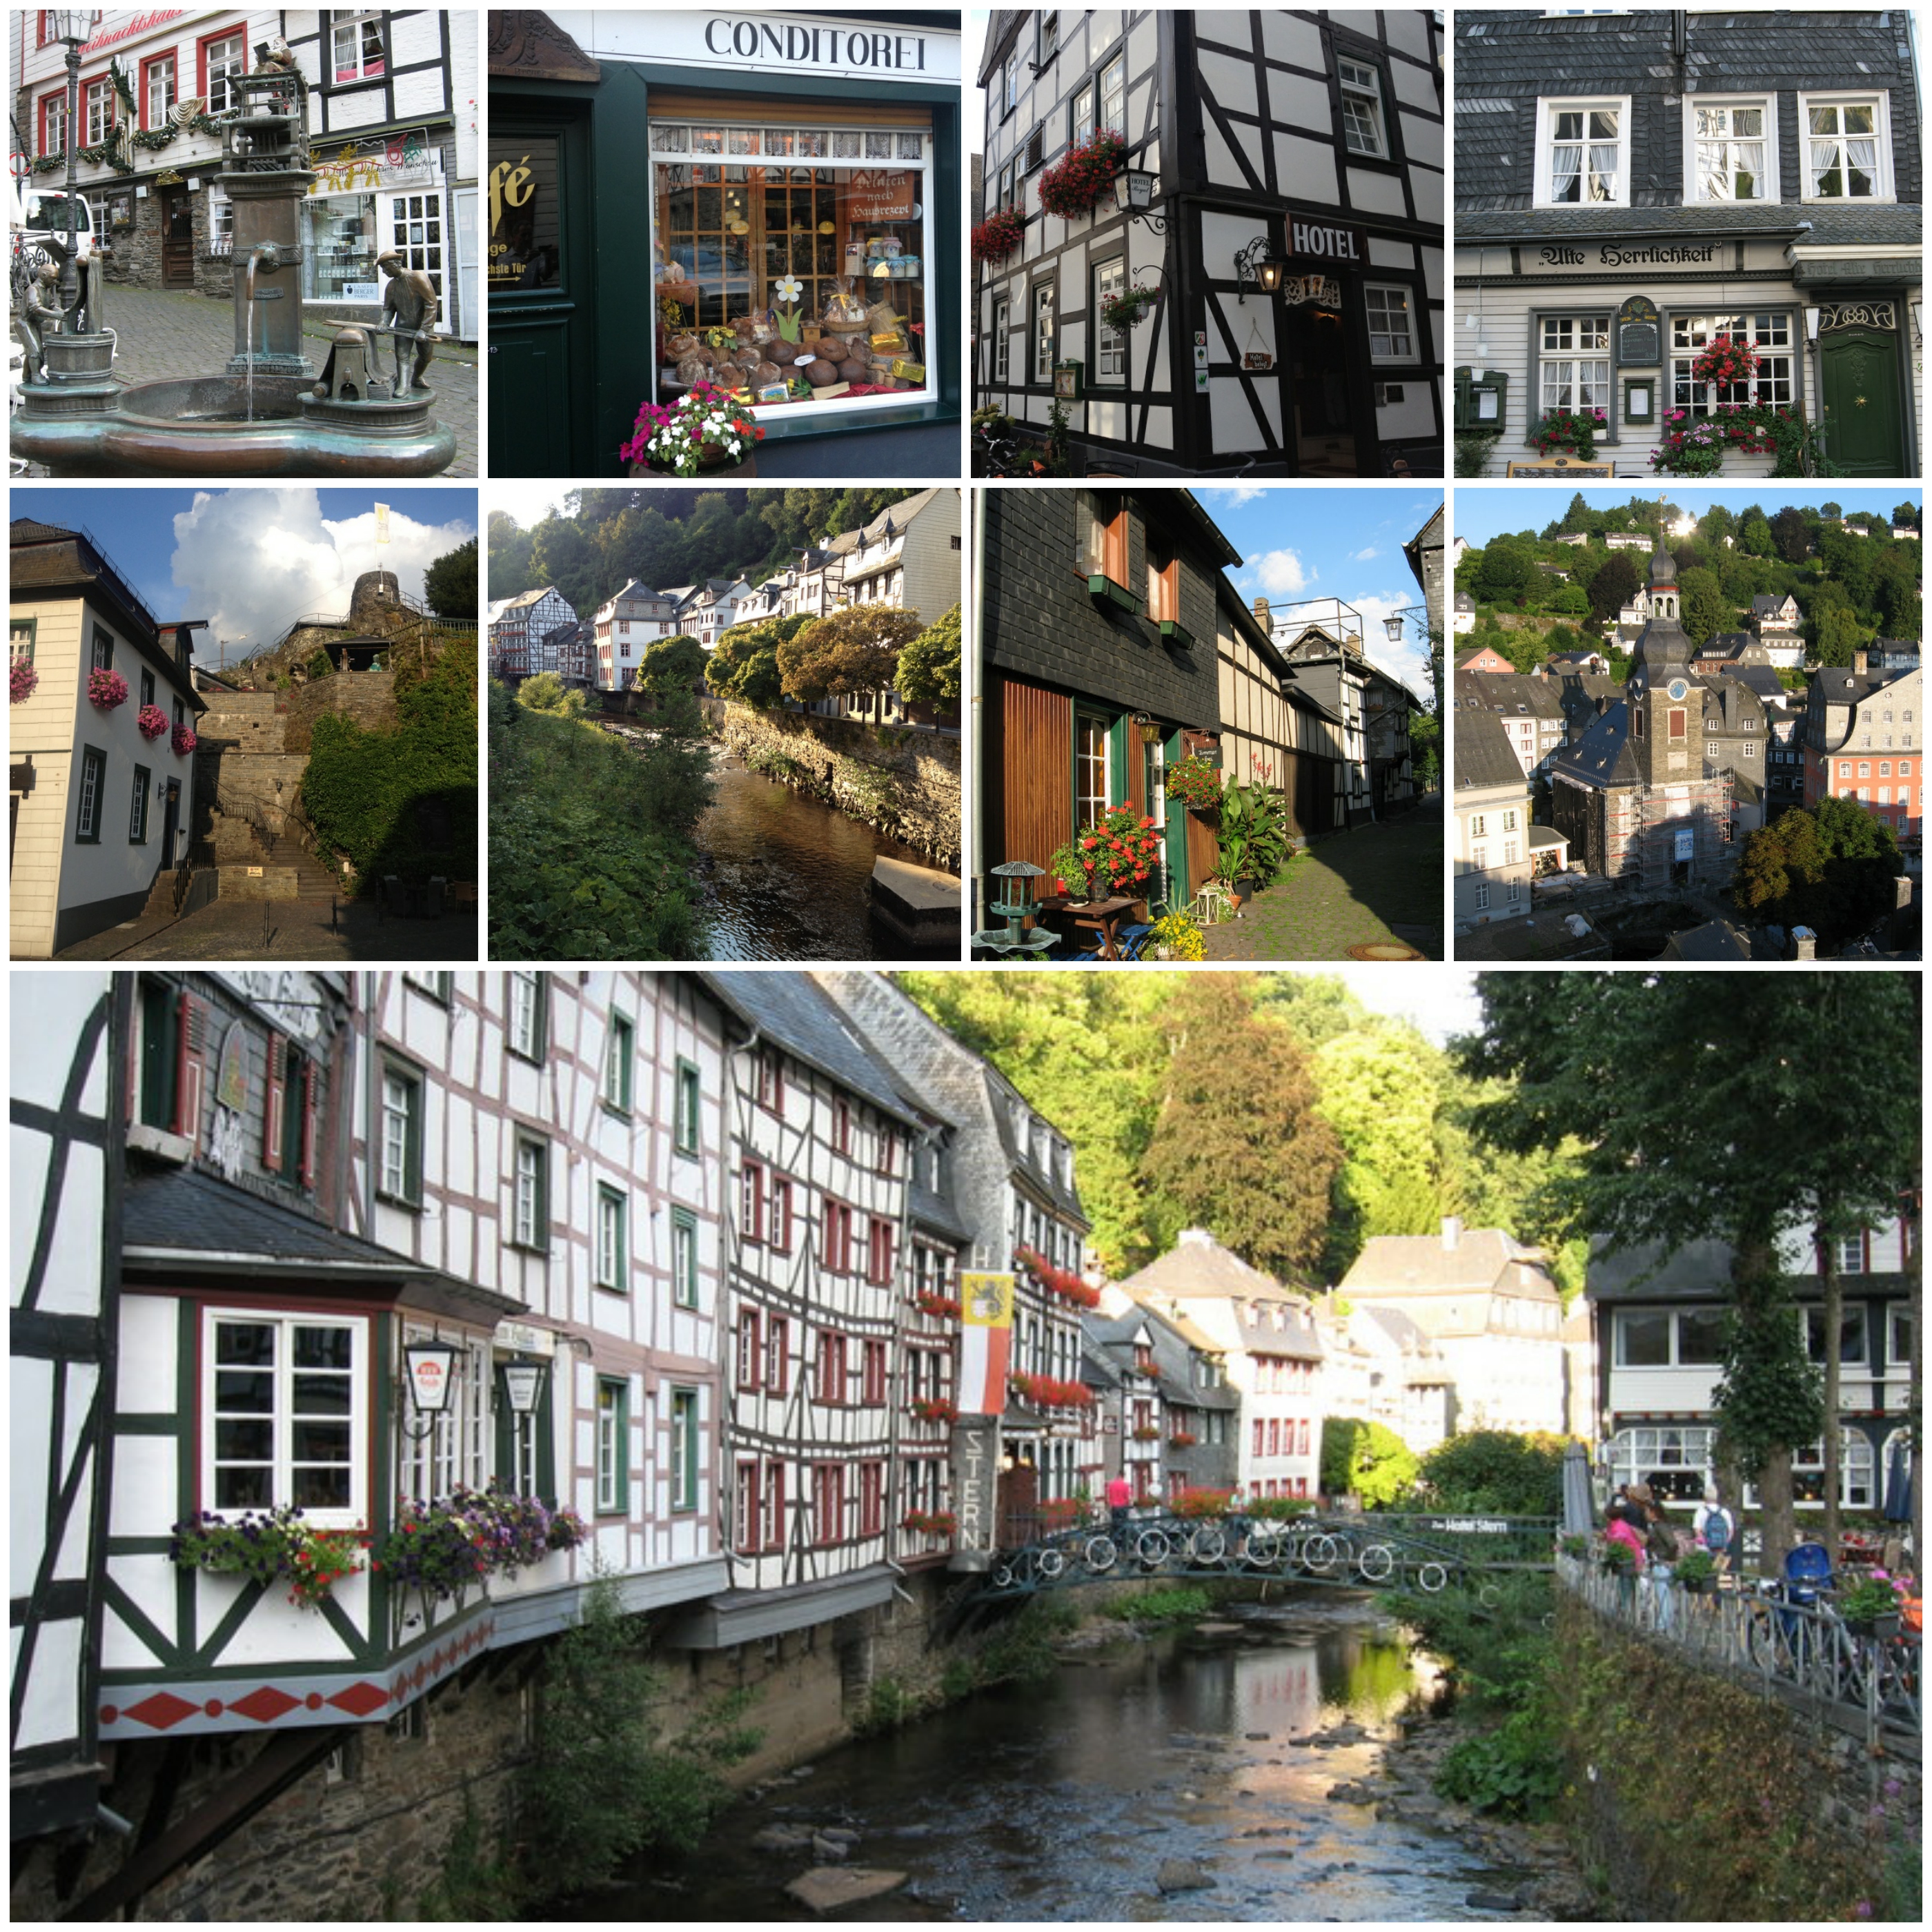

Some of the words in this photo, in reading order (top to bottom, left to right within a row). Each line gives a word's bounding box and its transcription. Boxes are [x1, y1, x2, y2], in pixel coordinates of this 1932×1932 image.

[704, 19, 926, 70] CONDITOREI
[1132, 177, 1150, 186] HOTEL
[867, 190, 894, 201] nach
[1132, 186, 1150, 194] Royal
[851, 204, 909, 217] Hausrezept
[1293, 222, 1360, 260] HOTEL
[488, 244, 507, 257] ge
[512, 263, 526, 273] Tür
[960, 1430, 984, 1550] STERN
